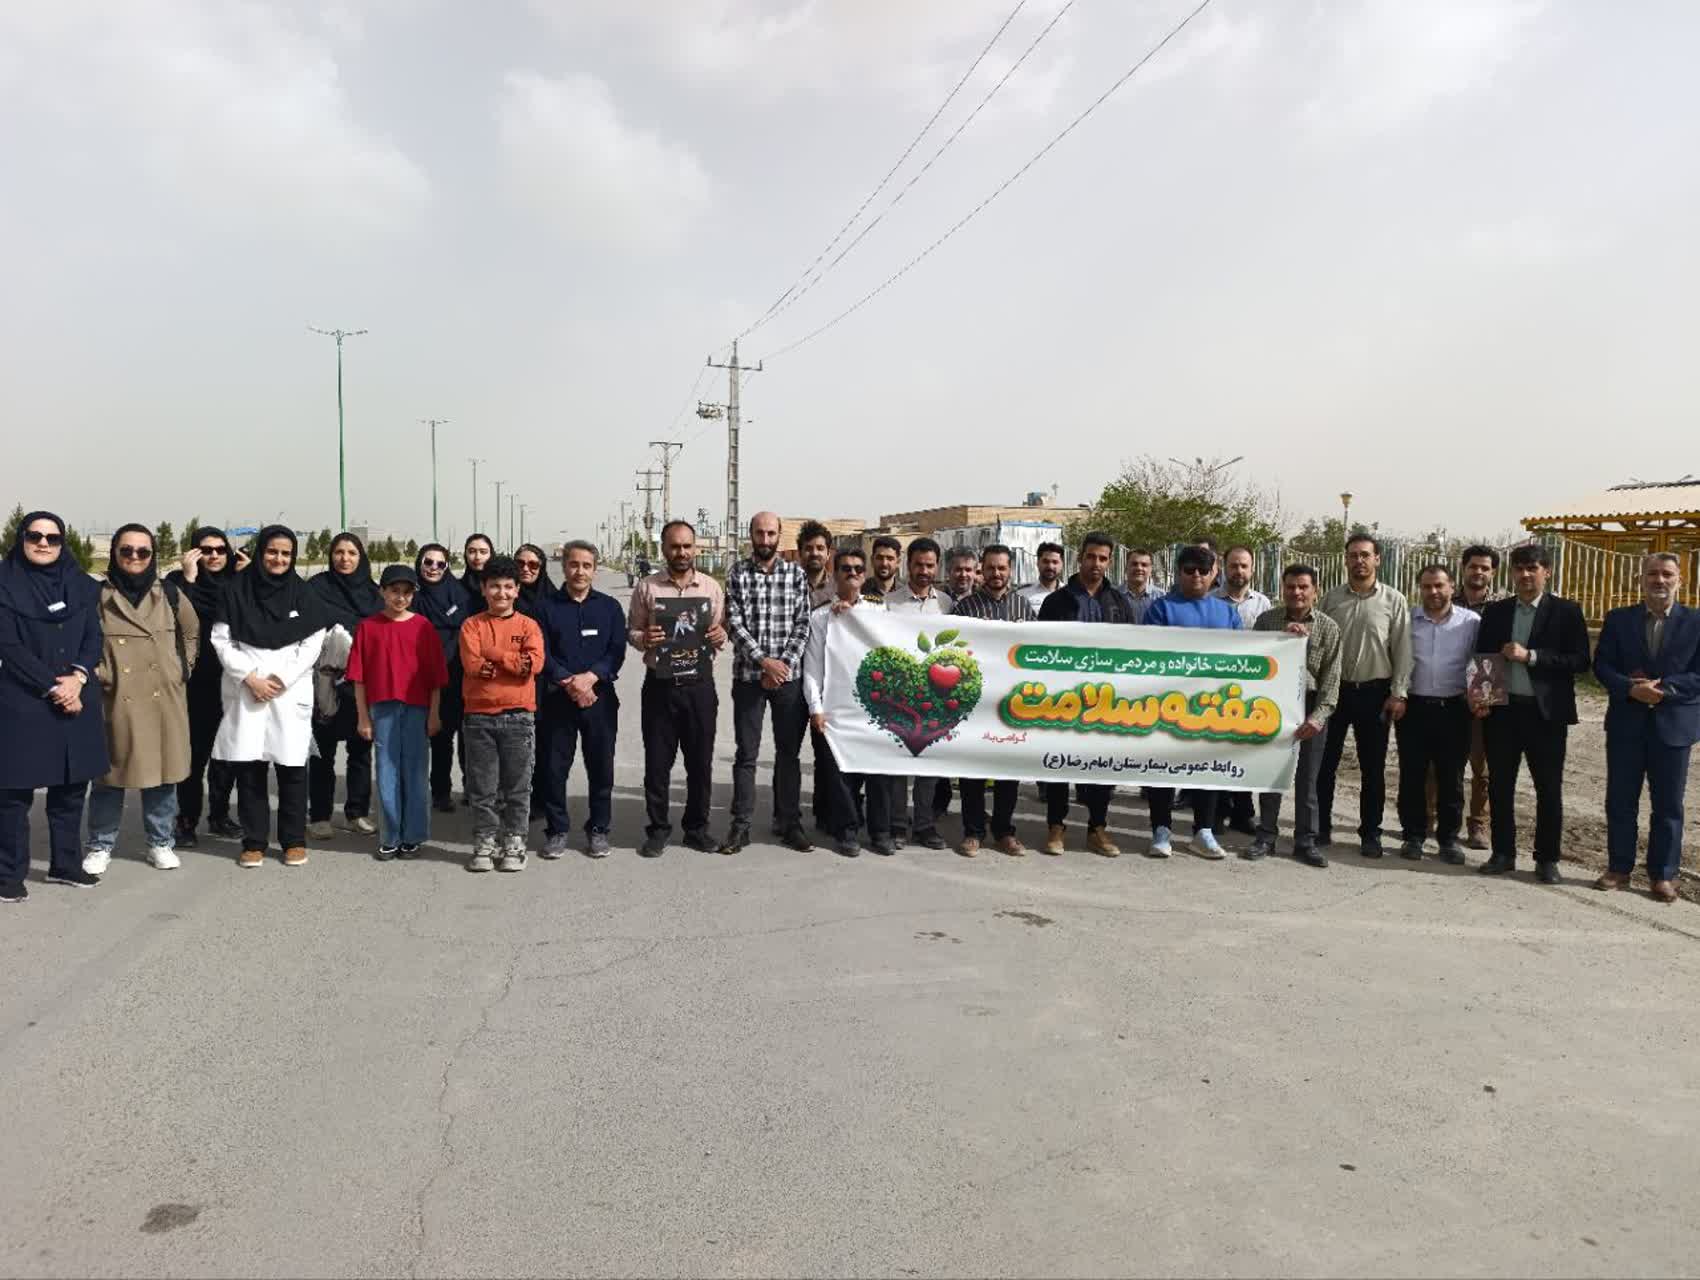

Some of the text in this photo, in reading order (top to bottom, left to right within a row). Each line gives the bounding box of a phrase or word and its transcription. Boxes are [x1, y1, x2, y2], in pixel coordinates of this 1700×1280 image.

[1024, 649, 1262, 677] سلامت خانواده و مردمی سازی سلامت
[1008, 683, 1281, 736] هفته سلامت
[1042, 752, 1245, 777] روابط عمومی بیمارستان امام رضا (ع)
